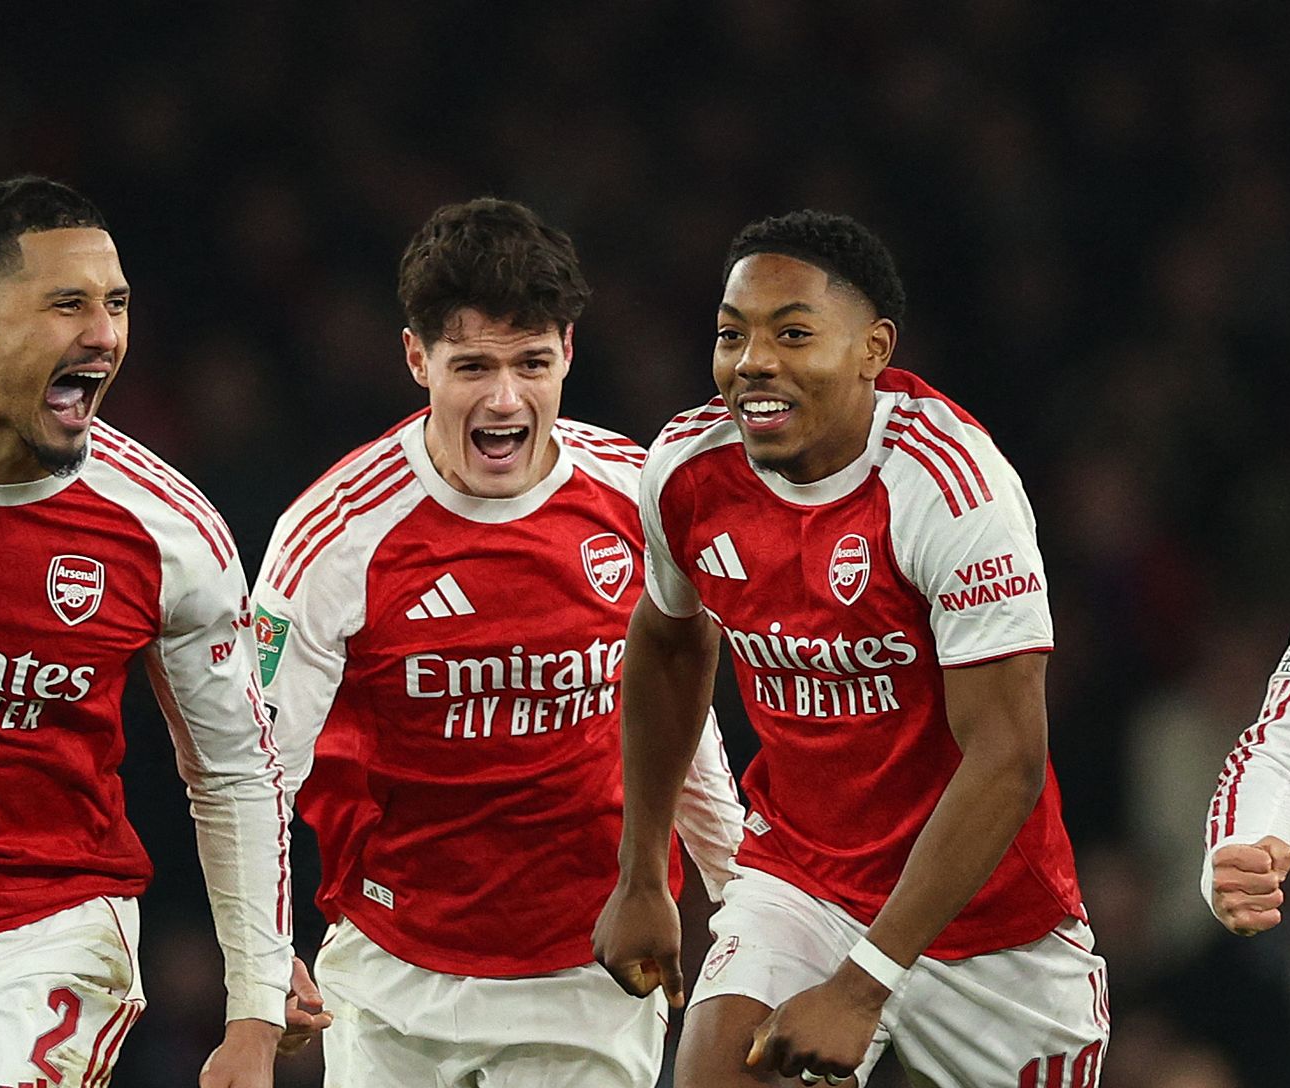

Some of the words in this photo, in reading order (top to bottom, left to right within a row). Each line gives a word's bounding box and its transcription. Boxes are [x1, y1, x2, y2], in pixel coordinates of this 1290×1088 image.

[590, 543, 624, 560] Arsenal
[954, 554, 1014, 585] VISIT
[57, 566, 97, 582] Arsenal
[938, 572, 1042, 611] RWANDA
[703, 606, 917, 675] mirates
[405, 637, 626, 698] Emirate
[443, 696, 500, 739] FLY
[510, 683, 615, 737] BETTER
[794, 675, 900, 718] BETTER
[29, 986, 84, 1085] 2
